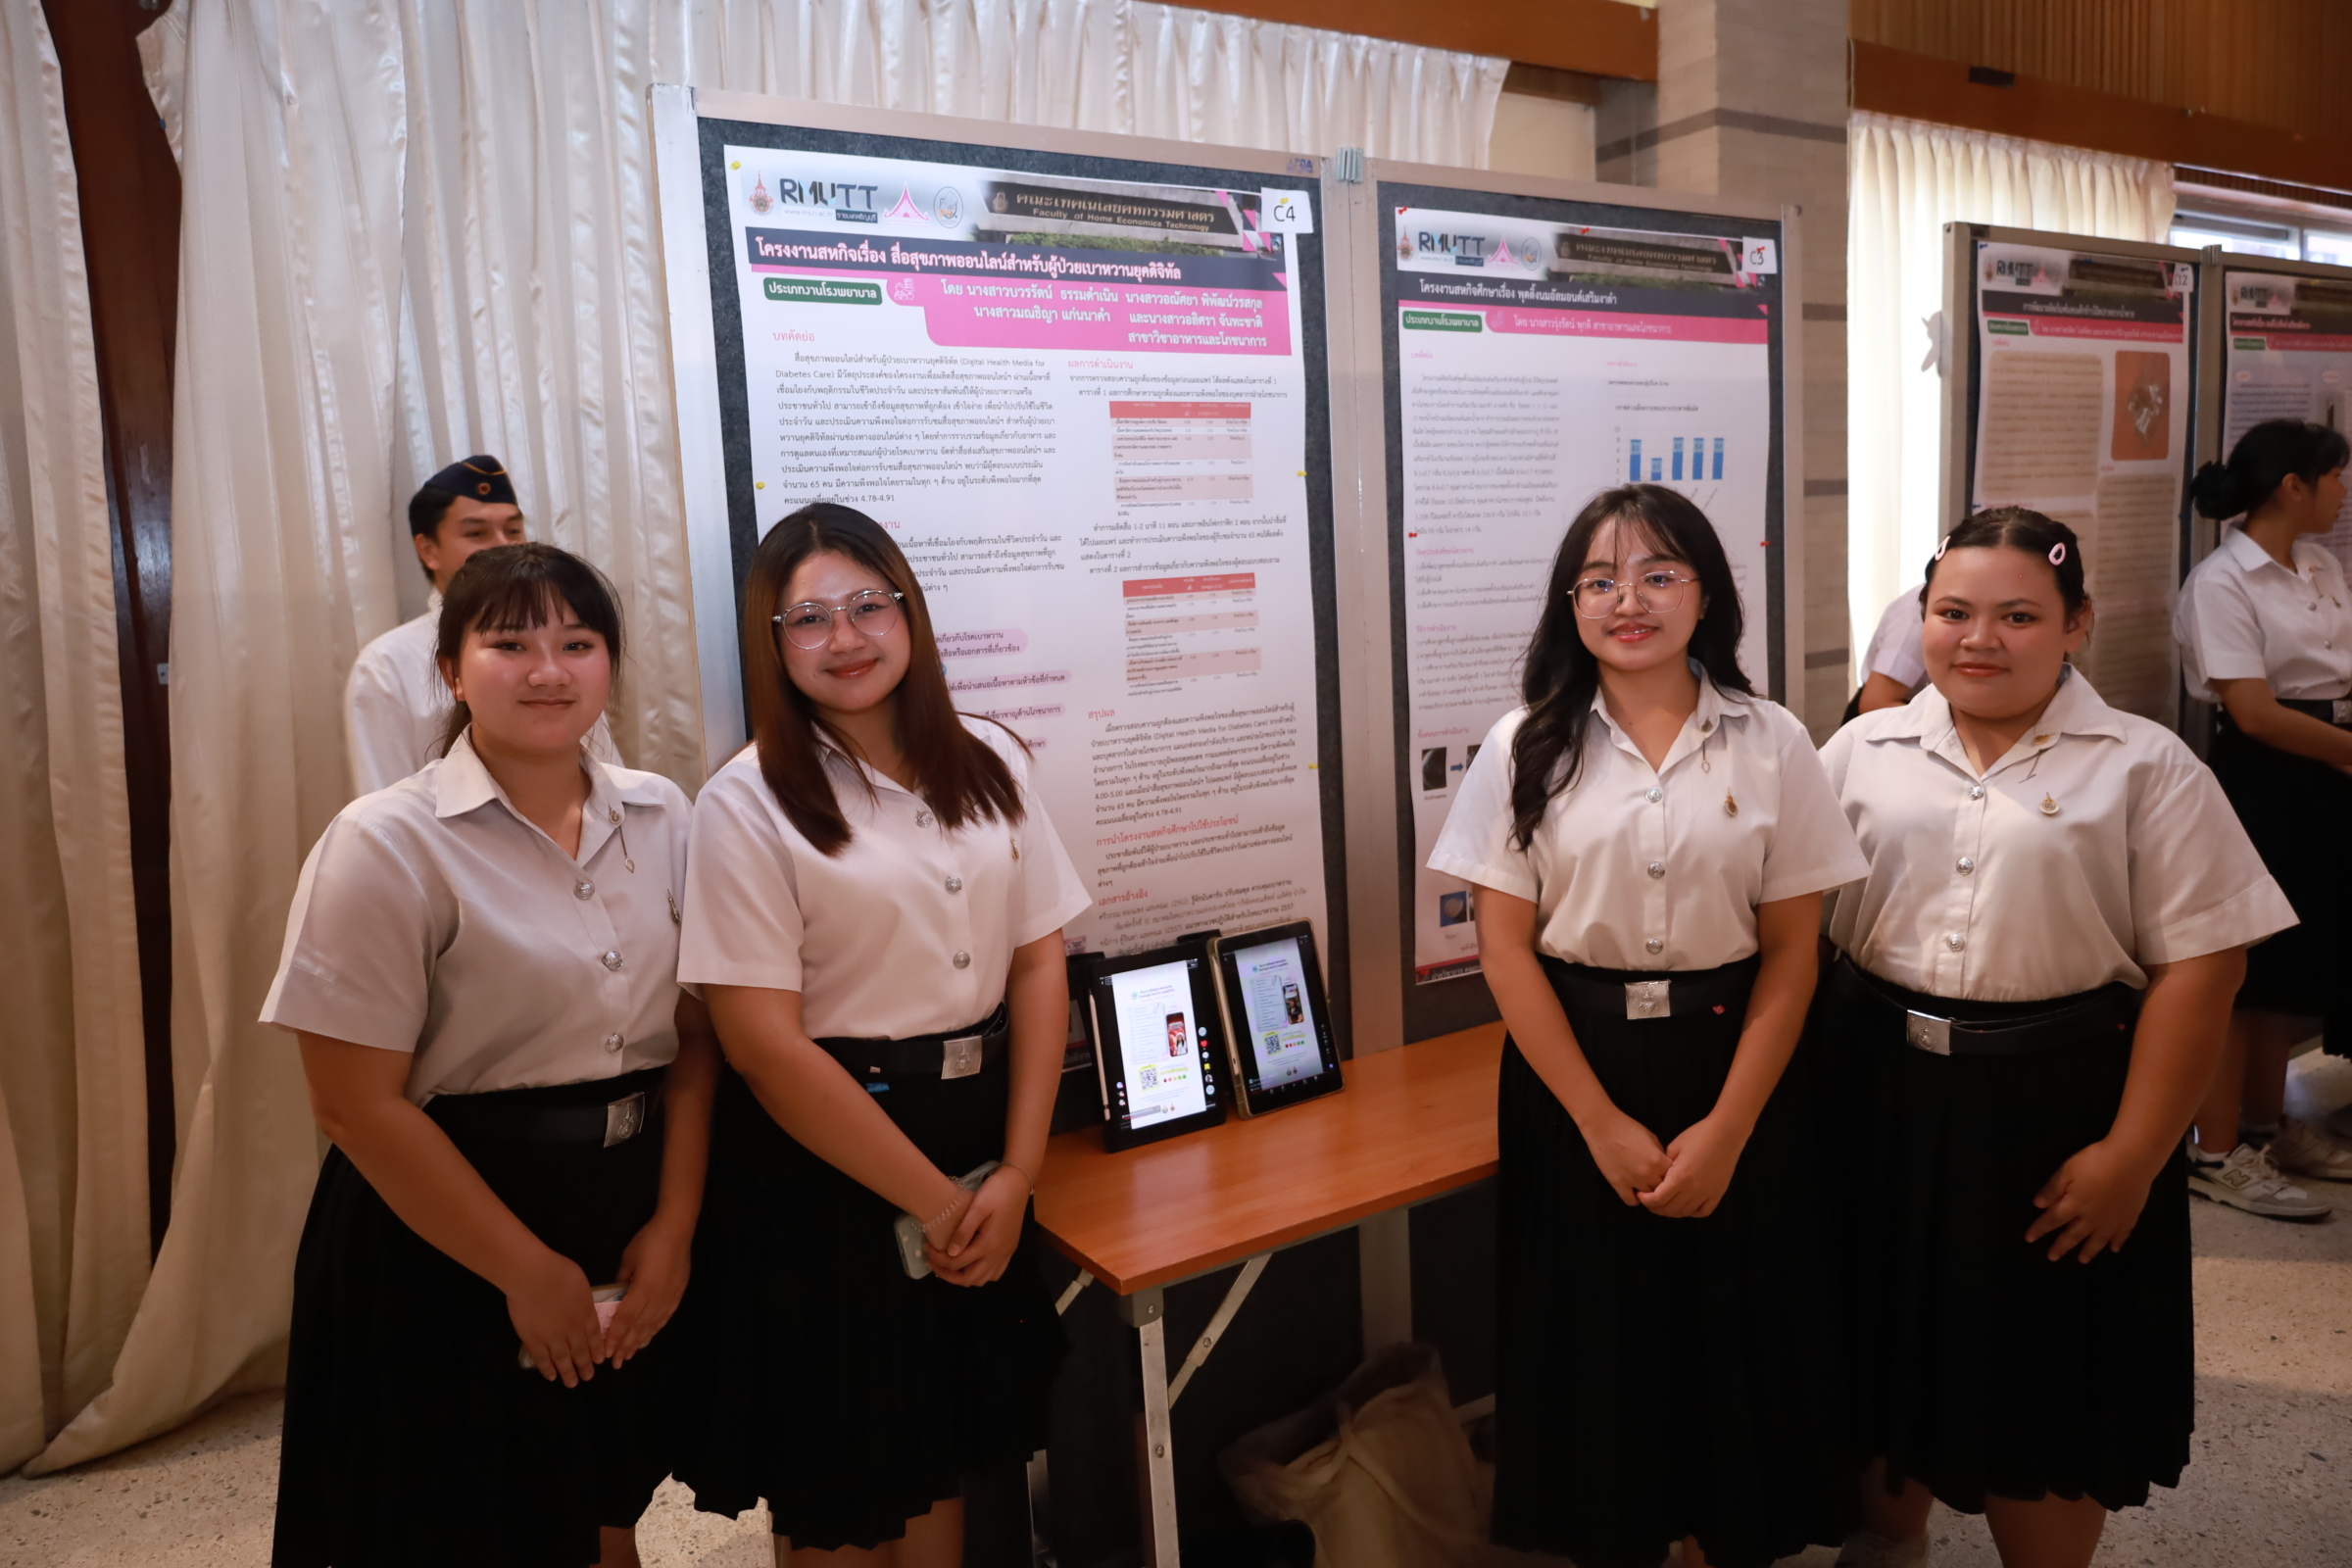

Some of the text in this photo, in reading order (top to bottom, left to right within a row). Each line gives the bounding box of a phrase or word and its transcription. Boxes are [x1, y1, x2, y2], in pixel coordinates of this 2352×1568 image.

[779, 178, 878, 210] RMUTT
[1033, 208, 1068, 220] Faculty
[1087, 214, 1112, 223] Home
[1116, 216, 1162, 228] Economics
[1165, 220, 1210, 232] Technology
[1273, 205, 1297, 222] C4
[1418, 231, 1486, 256] RMUTT
[755, 236, 1181, 282] โครงงานสหกิจเรื่อง สื่อสุขภาพออนไลน์สำหรับผู้ป่วยเบาหวานยุคดิจิทัล
[1749, 250, 1765, 266] C3
[768, 281, 877, 299] ประเภทงานโรงพยาบาล
[941, 278, 963, 295] โดย
[966, 283, 1054, 300] นางสาวบวรรัตน์
[1419, 278, 1516, 299] โครงงานสหกิจศึกษาเรื่อง
[1513, 315, 1528, 326] โดย
[772, 329, 815, 342] บทคัดย่อ
[1128, 329, 1267, 347] สาขาวิชาอาหารและโภชนาการ
[794, 351, 958, 368] สื่อสุขภาพออนไลน์สำหรับผู้ป่วยเบาหวานยุคดิจิทัล
[959, 357, 985, 367] (Digital
[1067, 357, 1134, 369] ผลการดำเนินงาน
[813, 370, 835, 379] Care)
[777, 398, 832, 411] ประชาชนทั่วไป
[778, 416, 812, 426] ประจำวัน
[782, 479, 808, 489] จำนวน
[941, 476, 955, 485] ด้าน
[860, 494, 895, 503] 4.78-4.91
[1145, 520, 1157, 530] นาที
[1088, 709, 1115, 721] สรุปผล
[1176, 728, 1198, 737] Health
[1198, 726, 1216, 735] Media
[1095, 790, 1123, 800] 4.00-5.00
[1155, 807, 1182, 817] 4.78-4.91
[1099, 888, 1148, 906] เอกสารอ้างอิง
